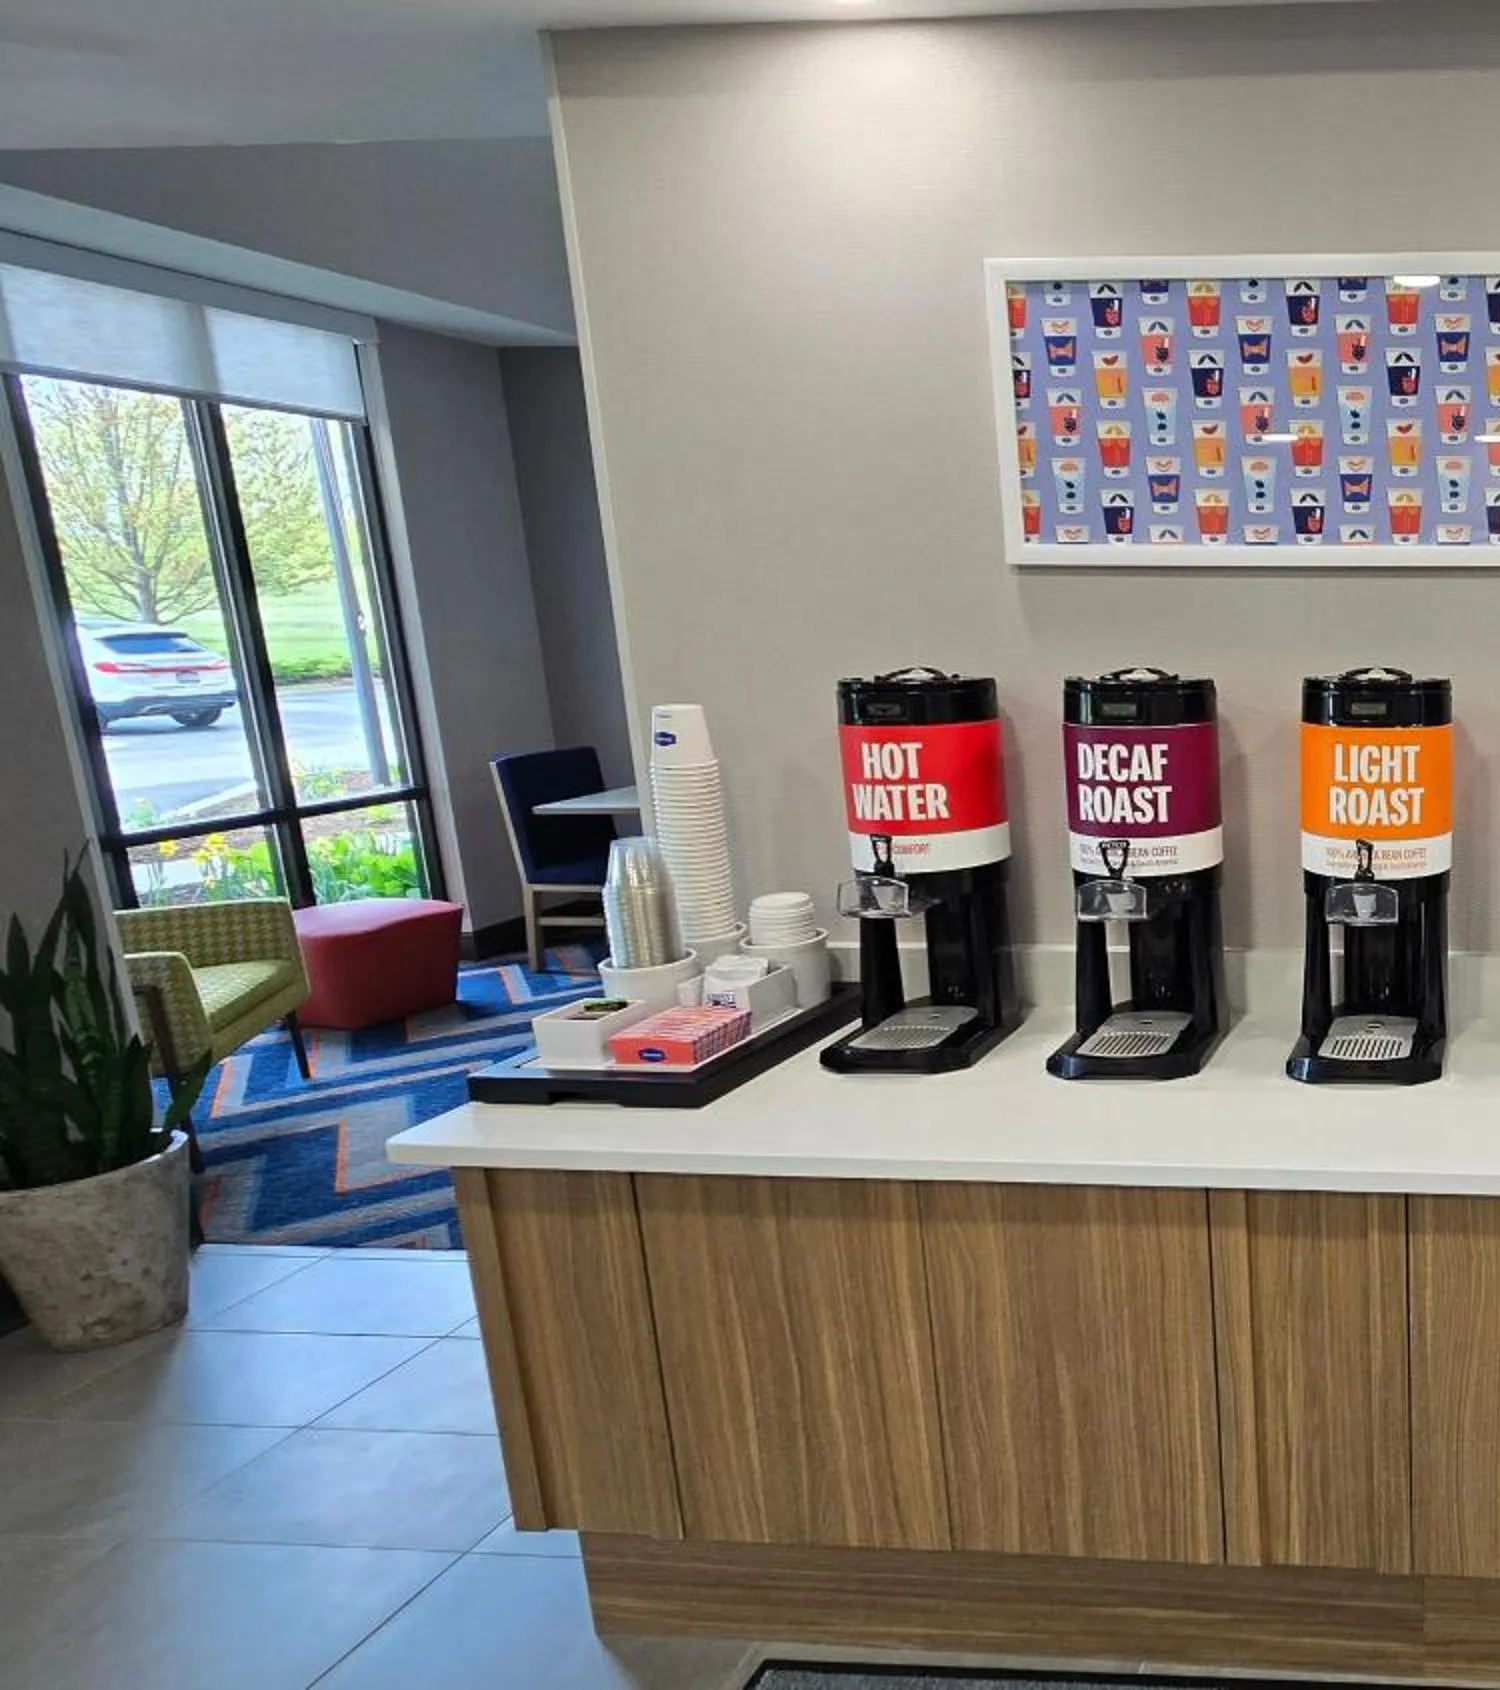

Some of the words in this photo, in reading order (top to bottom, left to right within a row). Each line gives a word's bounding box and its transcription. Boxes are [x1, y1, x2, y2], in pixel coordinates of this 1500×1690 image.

[861, 742, 923, 780] HOT
[1077, 743, 1169, 783] DECAF
[1334, 744, 1421, 784] LIGHT
[852, 783, 950, 821] WATER
[1078, 785, 1173, 824] ROAST
[1329, 786, 1425, 825] ROAST
